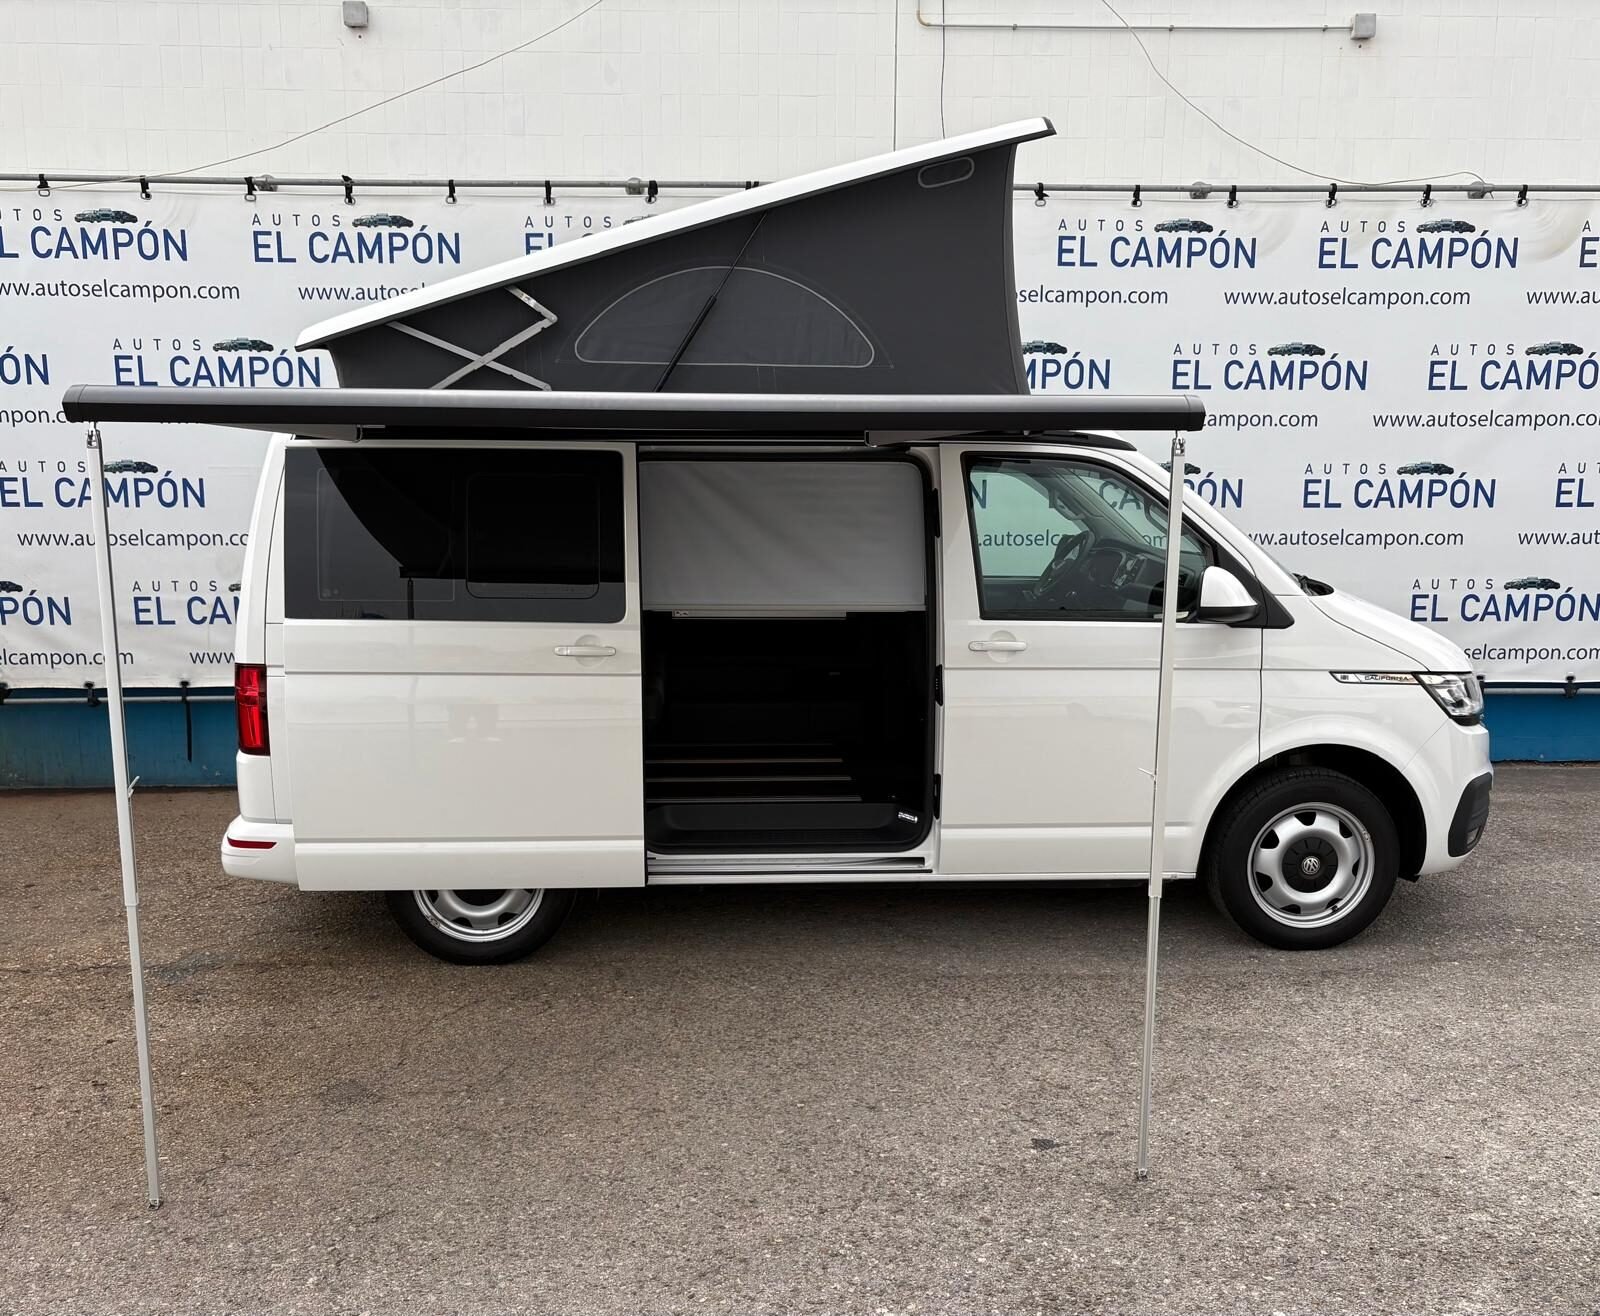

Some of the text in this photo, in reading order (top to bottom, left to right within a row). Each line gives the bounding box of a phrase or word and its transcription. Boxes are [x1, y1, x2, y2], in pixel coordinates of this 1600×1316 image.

[0, 208, 62, 221] TOS
[252, 213, 341, 227] AUTOS
[525, 215, 612, 228] AUTOS
[1058, 218, 1143, 231] AUTOS
[1320, 220, 1406, 233] AUTOS
[31, 220, 188, 261] CAMPÓN
[252, 225, 461, 264] EL CAMPÓN
[1057, 230, 1257, 269] EL CAMPÓN
[1318, 230, 1519, 269] EL CAMPÓN
[1579, 236, 1600, 268] E
[1016, 284, 1168, 308] selcampon.com
[1224, 286, 1470, 309] www.autoselcampon.com
[113, 338, 201, 351] AUTOS
[1173, 343, 1257, 356] AUTOS
[1430, 344, 1515, 356] AUTOS
[113, 348, 321, 387] EL CAMPÓN
[1171, 352, 1368, 390] EL CAMPÓN
[1427, 351, 1599, 390] EL CAMPÓ
[1203, 413, 1318, 431] ampon.com
[1373, 409, 1600, 431] www.autoselcampon.co
[0, 460, 86, 473] AUTOS
[1304, 463, 1387, 475] AUTOS
[0, 477, 44, 507] EL
[1302, 471, 1497, 509] EL CAMPÓN
[1555, 478, 1595, 508] EL
[132, 580, 218, 592] AUTOS
[1412, 578, 1494, 590] AUTOS
[133, 596, 177, 625] EL
[1410, 586, 1600, 622] EL CAMPÓN
